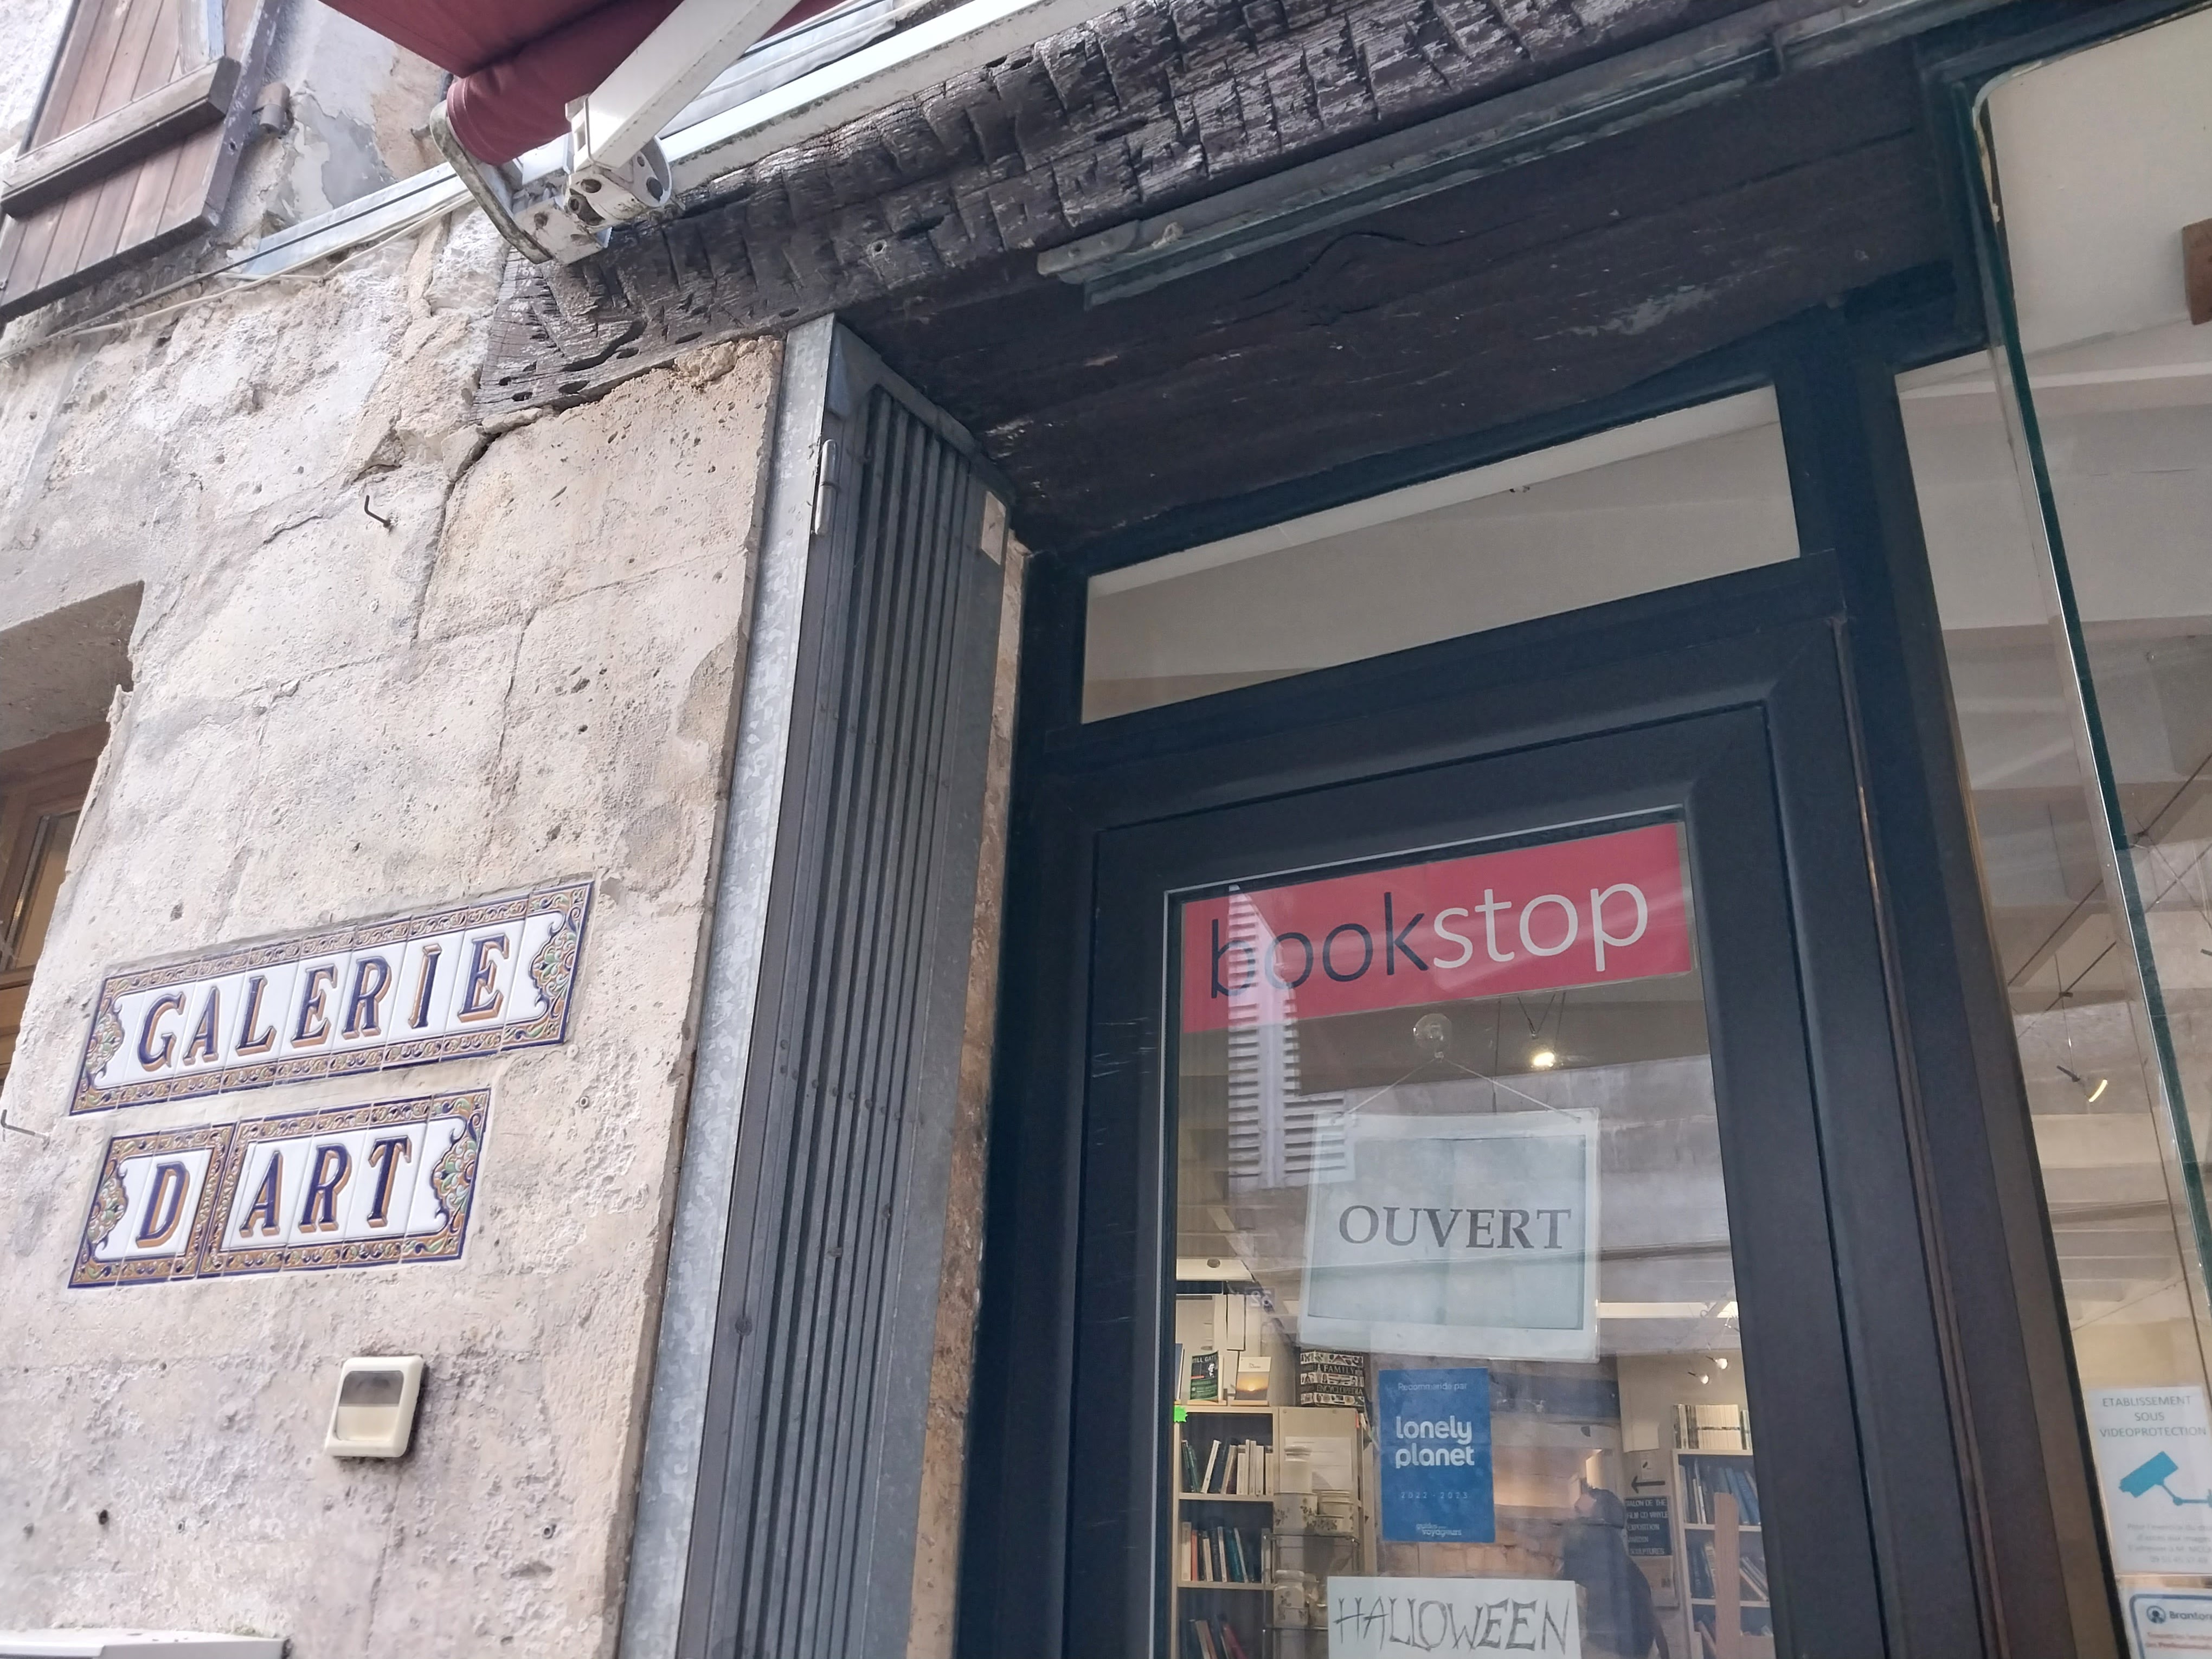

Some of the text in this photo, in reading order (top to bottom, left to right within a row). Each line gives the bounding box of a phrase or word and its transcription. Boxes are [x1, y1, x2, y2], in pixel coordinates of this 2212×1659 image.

[1211, 883, 1648, 999] bookstop
[137, 933, 511, 1072] GALERIE
[136, 1135, 413, 1249] D ART
[1339, 1205, 1572, 1250] OUVERT
[1324, 1364, 1355, 1374] FAMILY
[1316, 1384, 1364, 1397] ENCYCLOPEDIA
[1454, 1382, 1468, 1392] par
[2102, 1396, 2191, 1407] ETABLISSEMENT
[2134, 1411, 2165, 1422] SOUS
[1396, 1415, 1472, 1445] lonely
[2099, 1426, 2207, 1437] VIDEOPROTECTION
[1396, 1443, 1475, 1469] planet
[1333, 1596, 1570, 1655] HALLOWEEN
